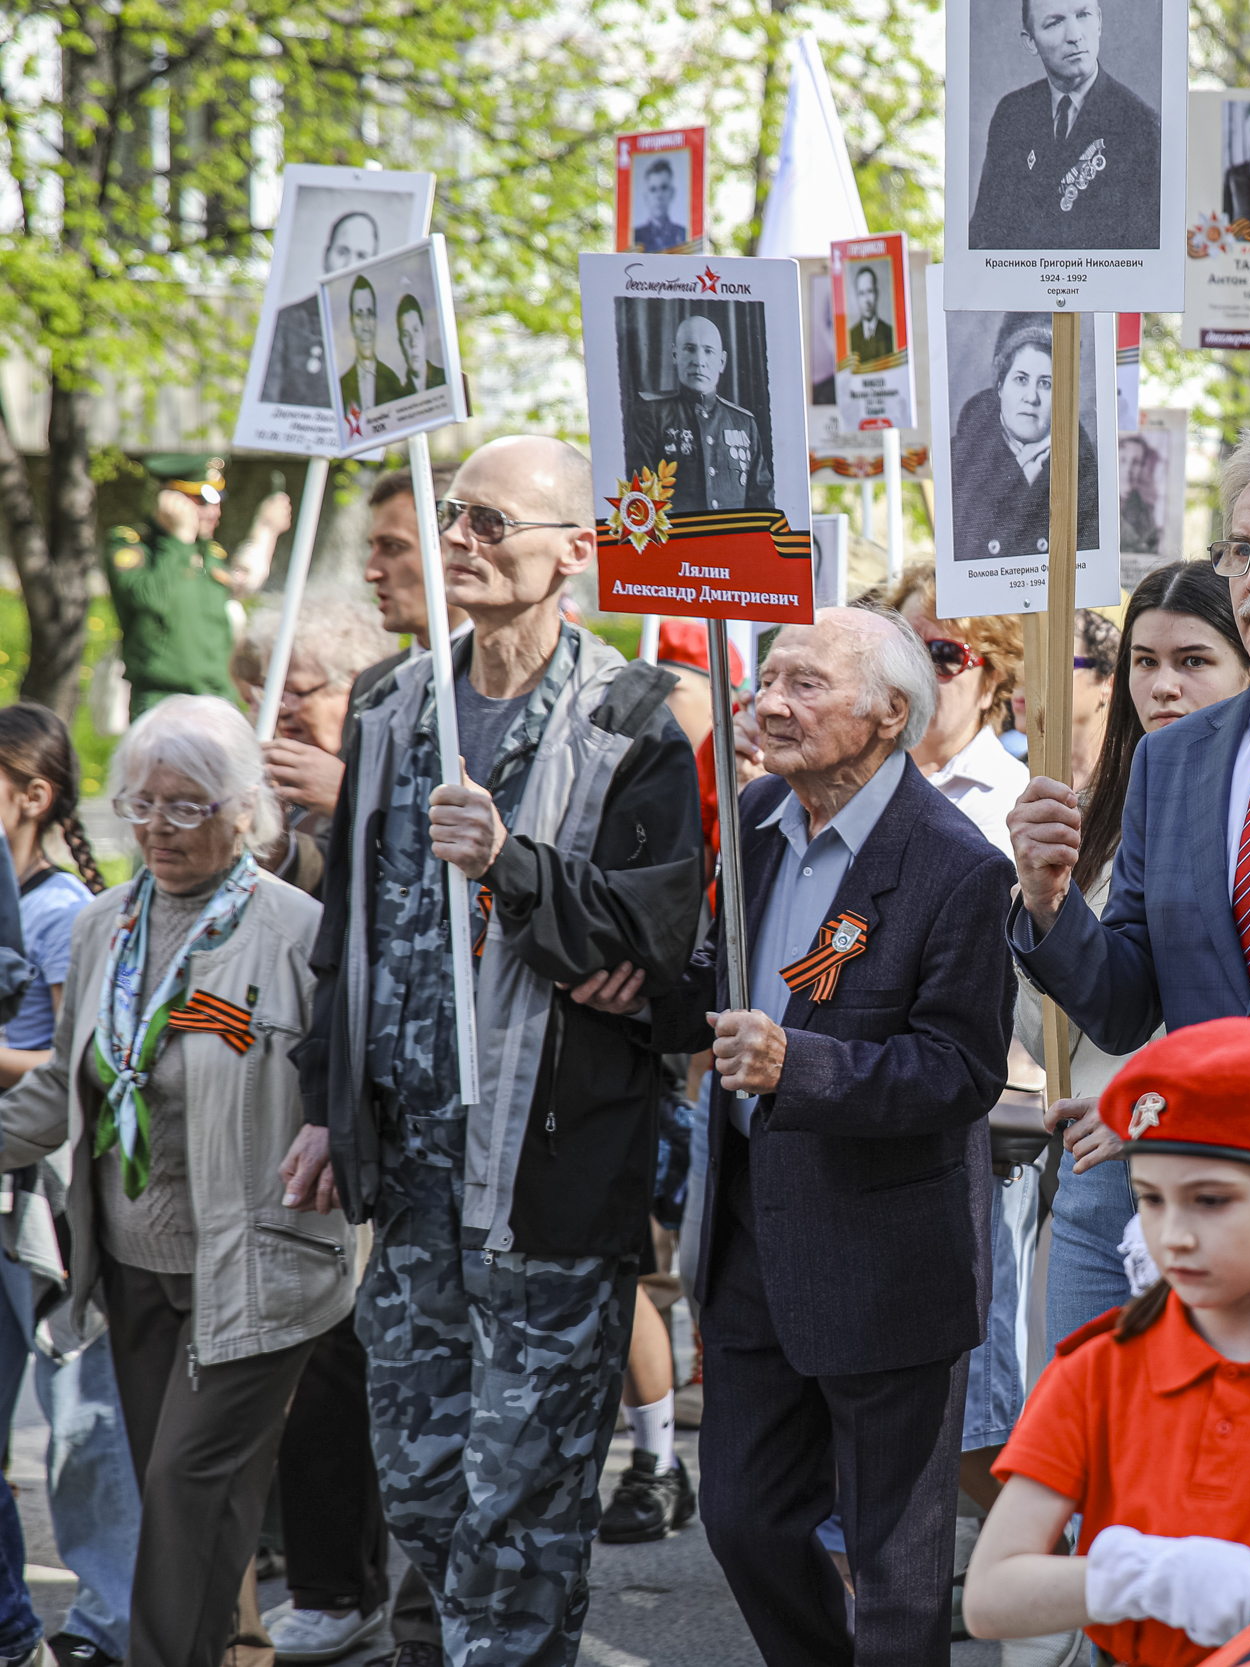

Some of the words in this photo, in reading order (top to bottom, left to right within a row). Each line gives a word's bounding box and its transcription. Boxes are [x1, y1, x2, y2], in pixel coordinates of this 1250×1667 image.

[985, 258, 1037, 269] Красников
[1039, 257, 1082, 269] Григорий
[1085, 257, 1143, 268] Николаевич
[1040, 274, 1060, 282] 1924
[1066, 274, 1087, 282] 1992
[1047, 287, 1079, 296] сержант
[678, 562, 730, 579] Лялин
[968, 568, 999, 579] Волкова
[1000, 565, 1039, 577] Екатерина
[1009, 581, 1026, 589] 1923
[1029, 579, 1046, 587] 1994
[612, 580, 697, 602] Александр
[699, 585, 799, 607] Дмитриевич
